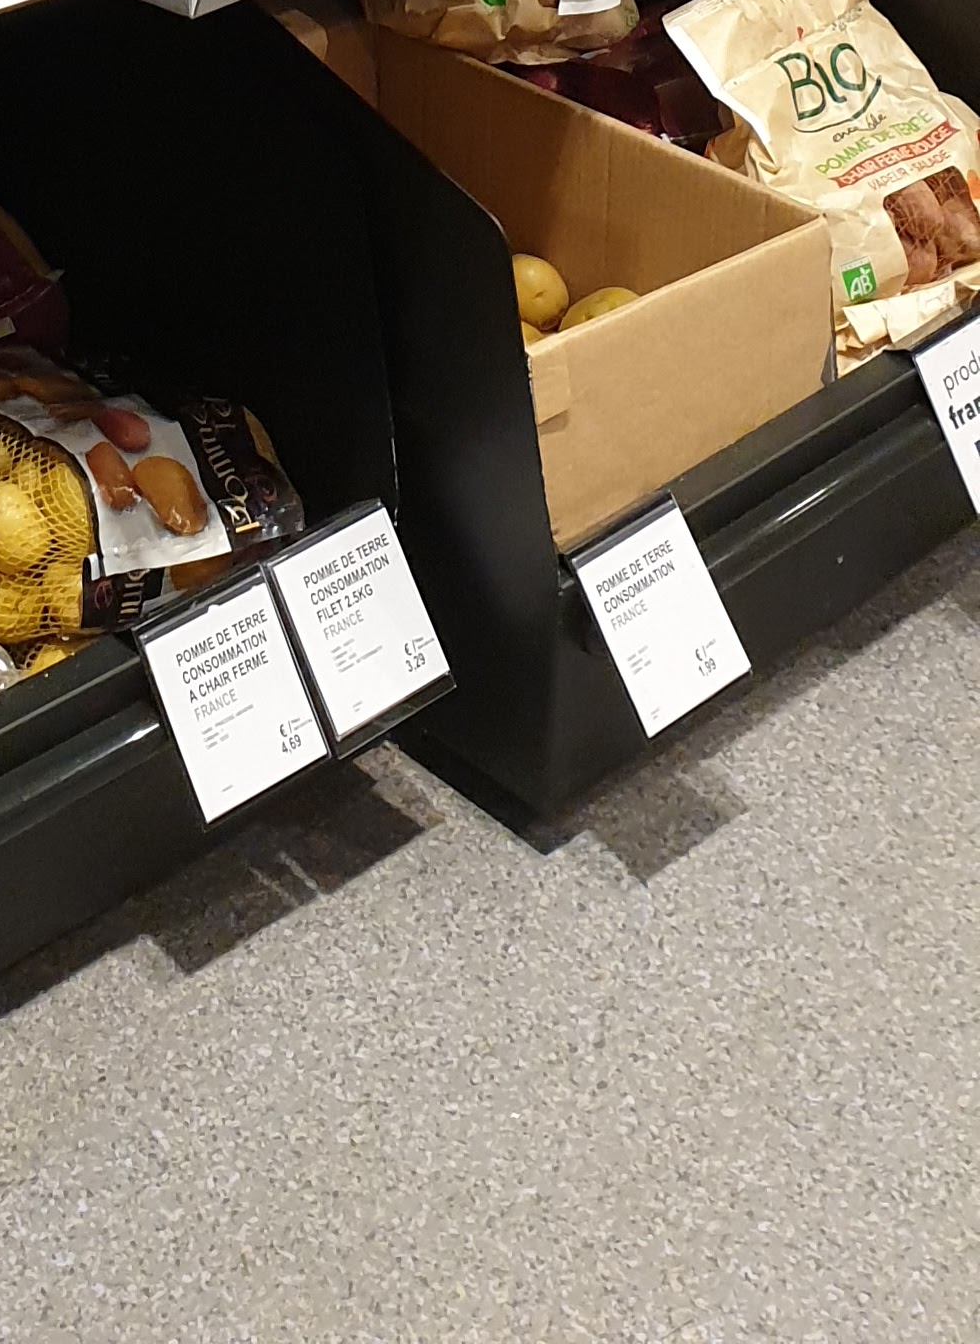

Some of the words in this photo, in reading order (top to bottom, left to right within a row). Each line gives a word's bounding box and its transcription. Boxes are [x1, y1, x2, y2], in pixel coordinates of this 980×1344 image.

[815, 136, 875, 175] POMME
[849, 275, 873, 302] AB
[942, 350, 980, 399] prod
[303, 560, 341, 589] POMME
[342, 550, 357, 569] DE
[356, 533, 390, 560] TERRE
[310, 553, 390, 606] CONSOMMATION
[596, 567, 630, 597] POMME
[629, 558, 644, 577] DE
[642, 540, 673, 567] TERRE
[316, 597, 344, 624] FILET
[344, 583, 374, 609] 2.5KG
[603, 560, 676, 614] CONSOMMATION
[175, 635, 216, 667] POMME
[216, 627, 232, 645] DE
[232, 608, 268, 636] TERRE
[323, 609, 364, 641] FRANCE
[610, 599, 649, 631] FRANCE
[182, 630, 268, 685] CONSOMMATION
[188, 688, 196, 704] A
[198, 667, 233, 698] CHAIR
[232, 650, 269, 679] FERME
[194, 687, 238, 722] FRANCE
[281, 734, 302, 755] 4,69
